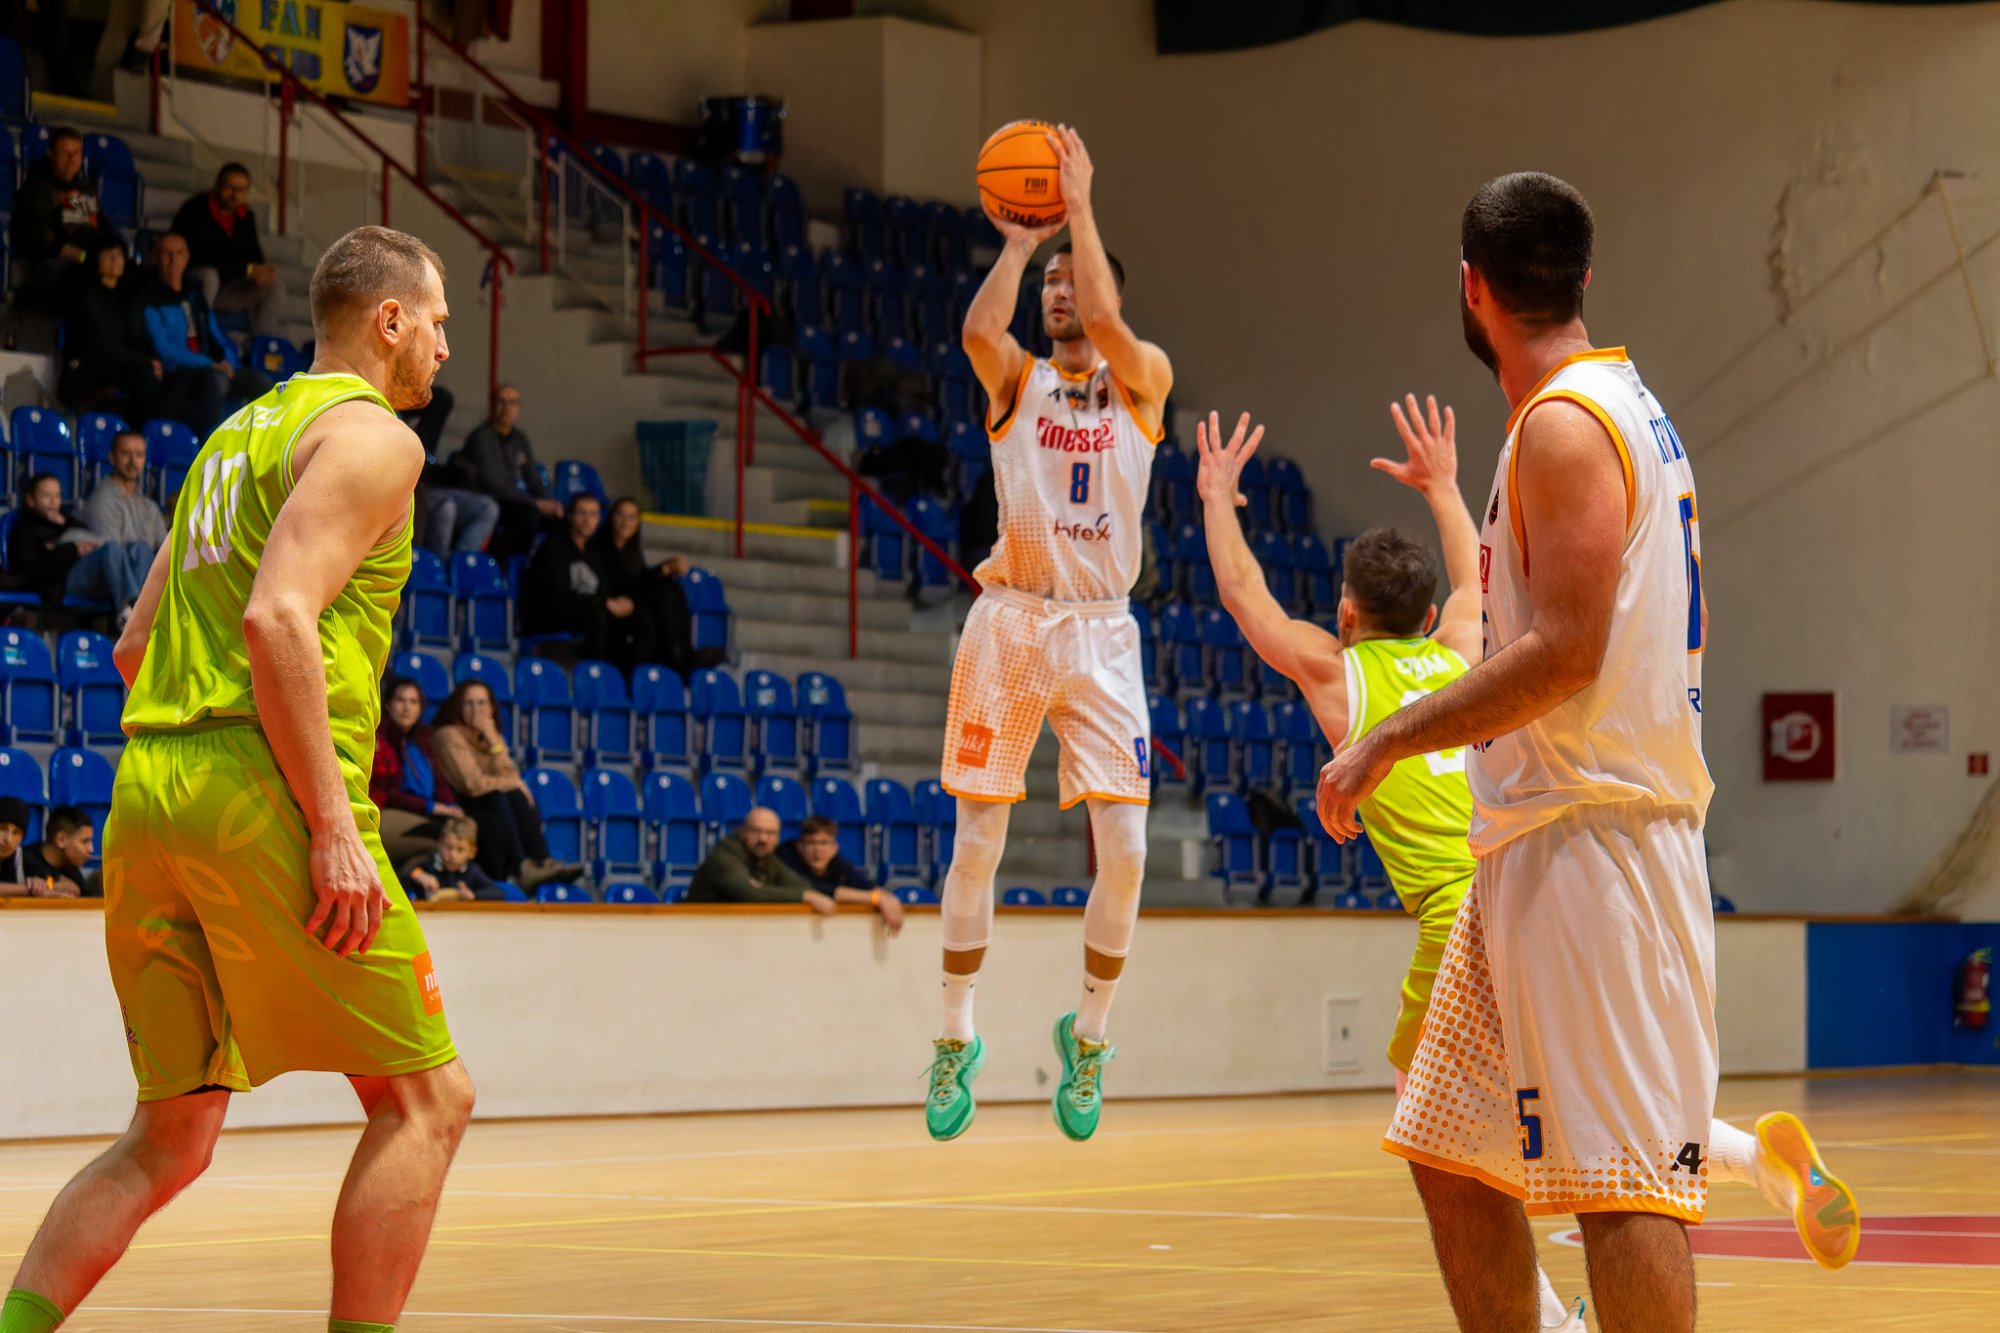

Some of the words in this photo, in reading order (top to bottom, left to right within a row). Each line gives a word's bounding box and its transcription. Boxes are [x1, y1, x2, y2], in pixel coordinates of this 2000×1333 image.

[260, 0, 322, 40] FAN
[1070, 462, 1090, 504] 8
[1134, 736, 1150, 778] 8
[1516, 1087, 1545, 1162] 5
